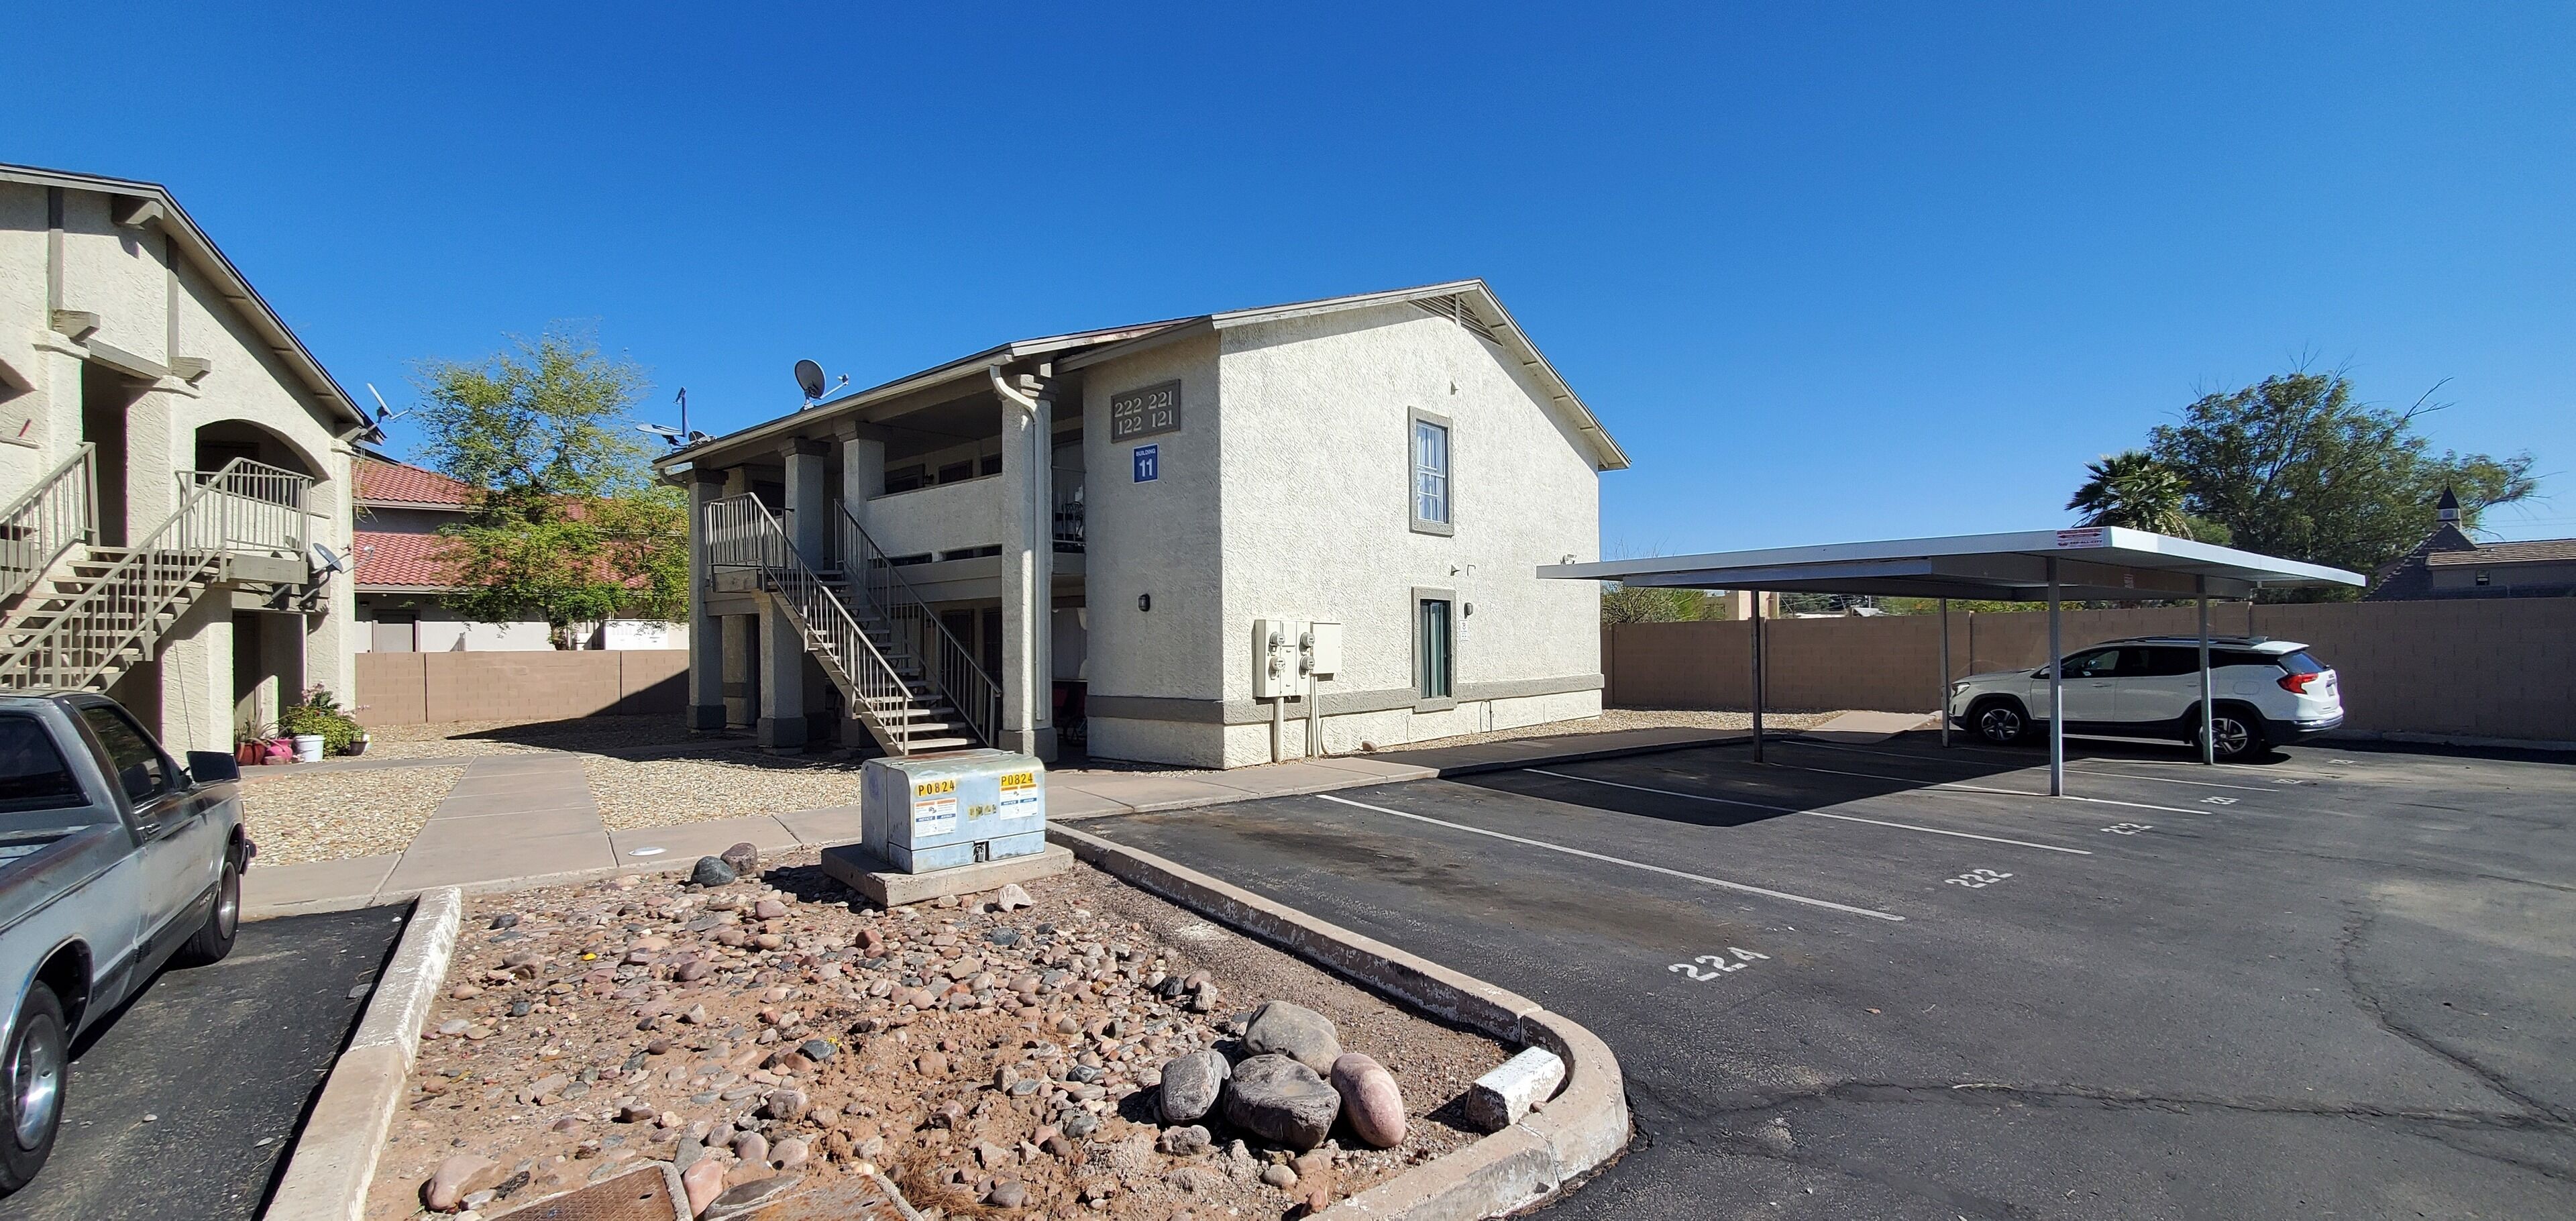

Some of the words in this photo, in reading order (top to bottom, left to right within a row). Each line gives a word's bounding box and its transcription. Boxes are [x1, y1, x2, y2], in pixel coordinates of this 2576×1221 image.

[1115, 398, 1142, 417] 222
[1148, 390, 1173, 409] 221
[1119, 416, 1142, 435] 122
[1152, 410, 1173, 427] 121
[1136, 448, 1155, 457] BUILDING
[1139, 458, 1152, 477] 11
[918, 780, 955, 796] P0824
[1002, 773, 1033, 786] P0824
[1945, 869, 2013, 888] 222
[1668, 947, 1771, 981] 224
